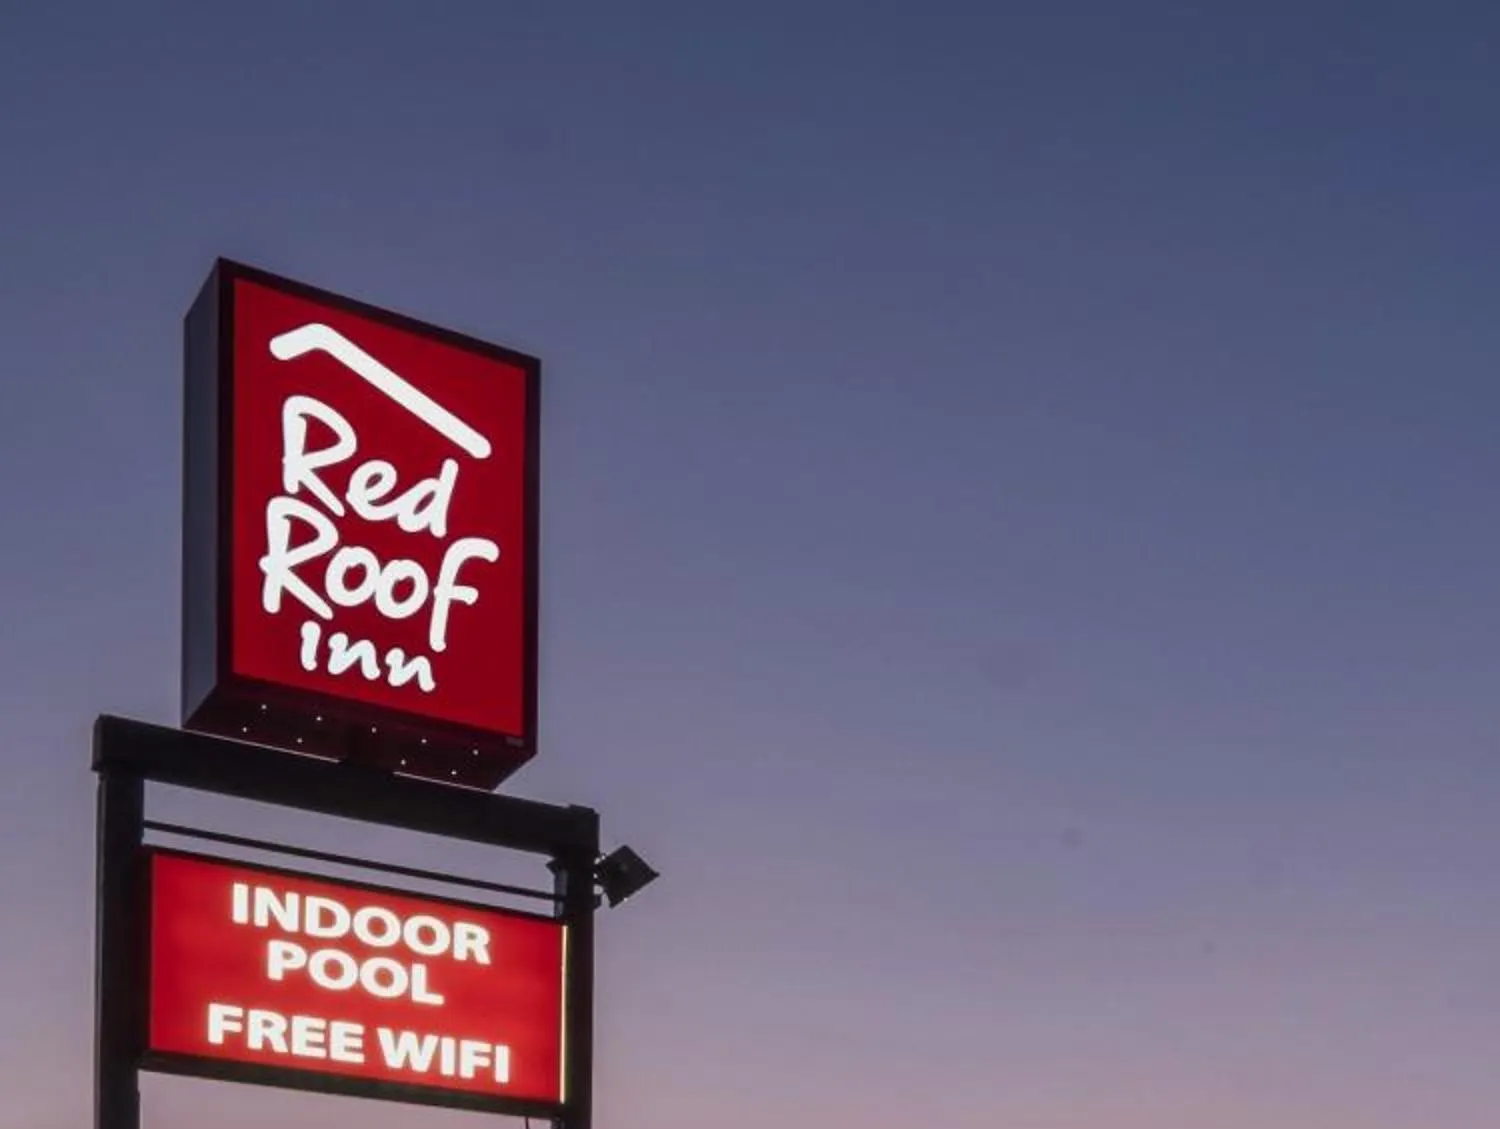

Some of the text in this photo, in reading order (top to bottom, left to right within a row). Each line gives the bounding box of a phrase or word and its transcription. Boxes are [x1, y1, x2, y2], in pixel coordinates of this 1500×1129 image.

[281, 394, 459, 538] Red
[258, 496, 500, 652] Roof
[300, 620, 436, 692] inn
[231, 882, 492, 966] INDOOR
[266, 939, 446, 1006] POOL
[206, 1003, 511, 1084] FREE WIFI
